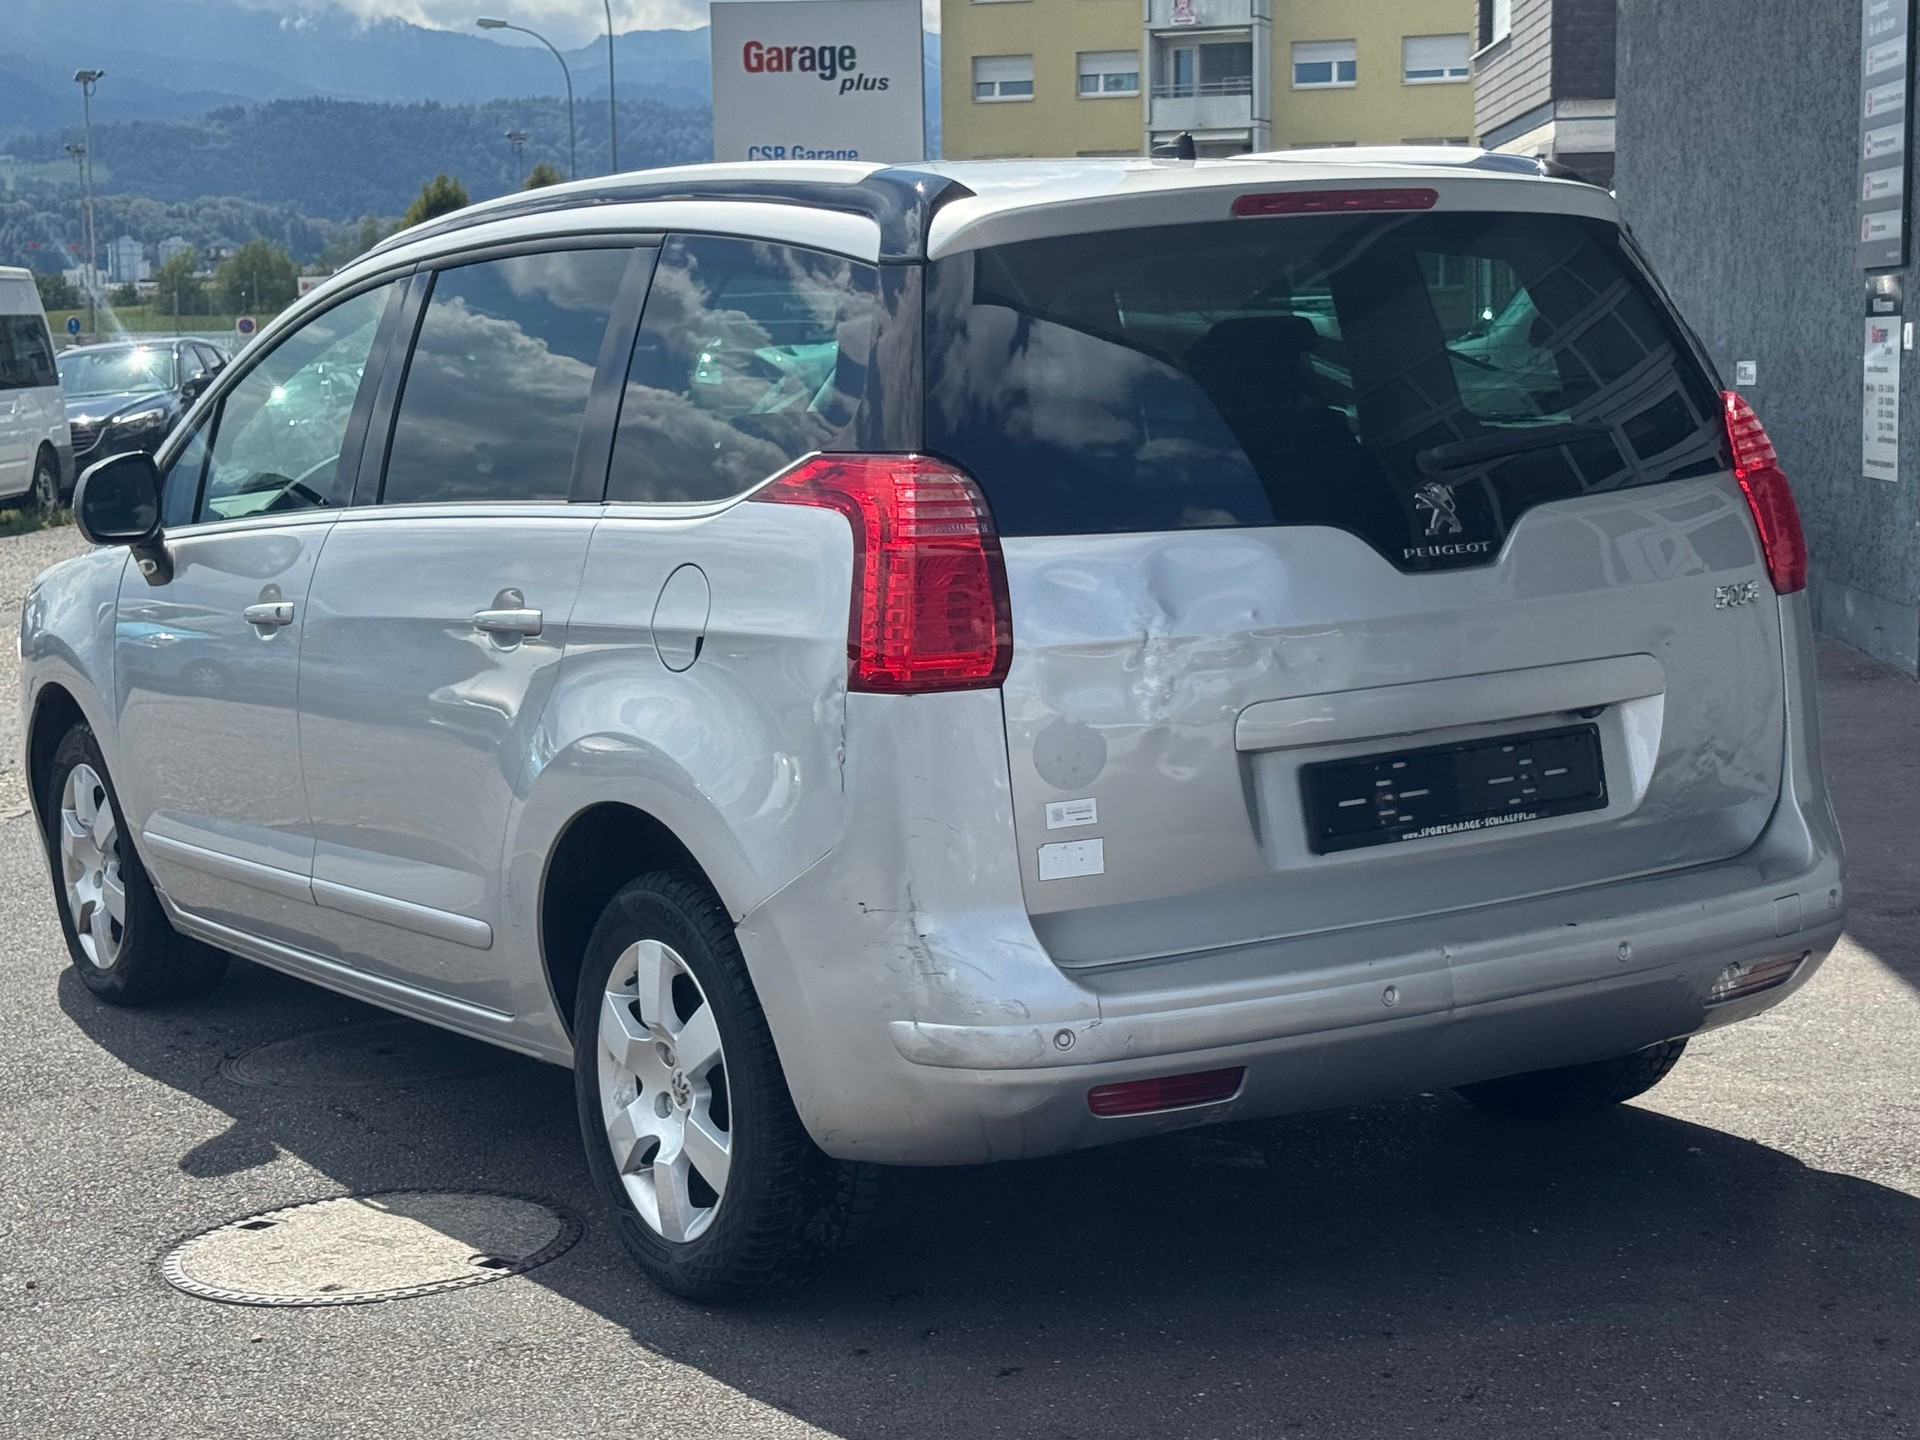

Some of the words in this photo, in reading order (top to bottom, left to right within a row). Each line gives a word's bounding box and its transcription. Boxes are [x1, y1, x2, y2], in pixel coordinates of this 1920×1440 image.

[743, 40, 857, 81] Garage
[838, 73, 890, 96] plus
[1403, 541, 1491, 559] PEUGEOT
